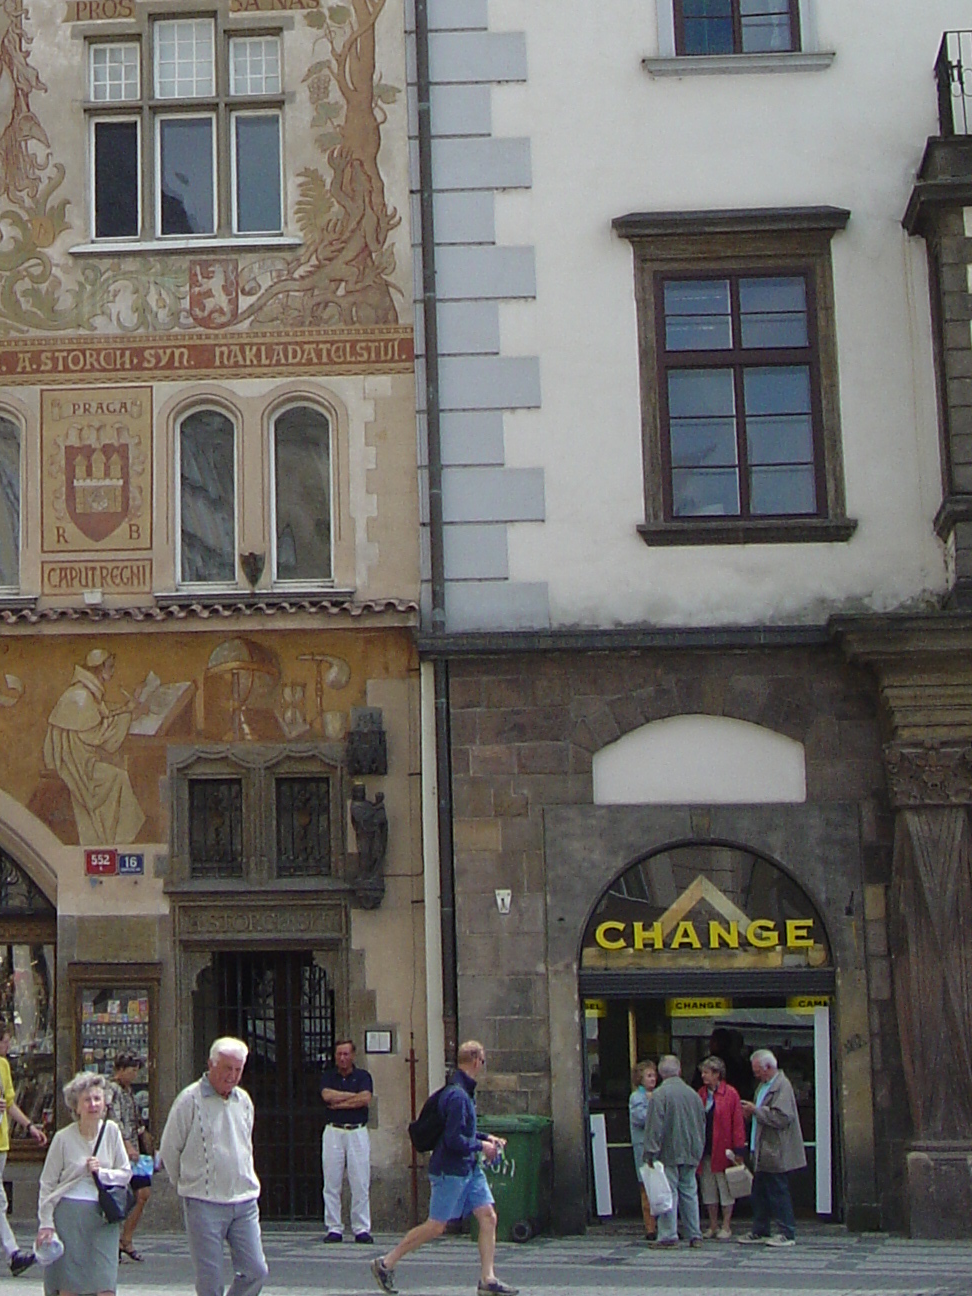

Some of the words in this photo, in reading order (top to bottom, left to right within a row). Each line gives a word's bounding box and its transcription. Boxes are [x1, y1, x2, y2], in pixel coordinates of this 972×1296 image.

[71, 401, 129, 416] PRAGA
[56, 525, 69, 544] R
[129, 524, 141, 541] B
[91, 854, 110, 866] 552
[124, 856, 138, 868] 16
[595, 918, 815, 951] CHANGE
[675, 1001, 722, 1010] CHANGE
